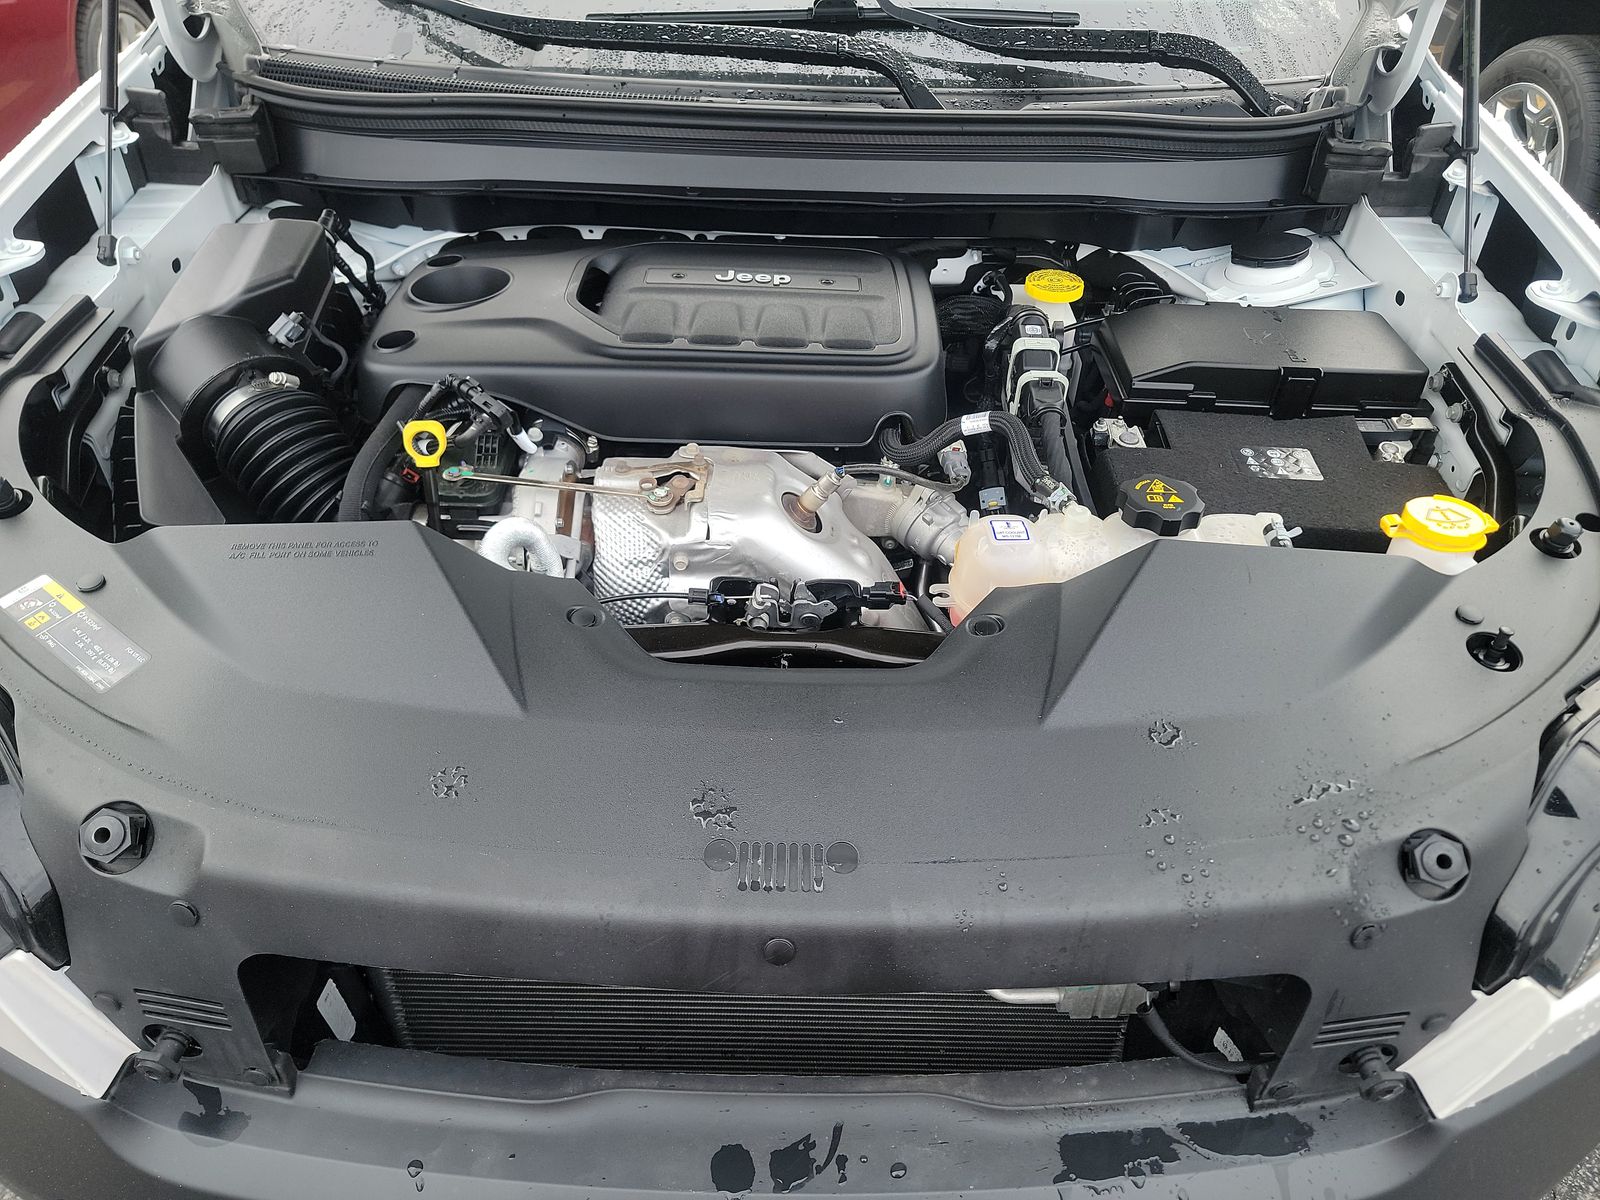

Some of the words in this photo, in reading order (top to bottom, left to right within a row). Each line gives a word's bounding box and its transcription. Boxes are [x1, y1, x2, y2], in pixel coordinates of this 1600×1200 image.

[715, 270, 791, 286] Jeep
[231, 543, 266, 551] REMOVE
[267, 542, 286, 550] THIS
[287, 541, 314, 550] PANEL
[315, 541, 333, 549] FOR
[333, 540, 366, 549] ACCESS
[368, 540, 379, 548] TO
[228, 552, 246, 560] A/C
[249, 551, 266, 559] FILL
[268, 551, 291, 559] PORT
[293, 550, 307, 558] ON
[307, 550, 333, 558] SOME
[335, 549, 375, 558] VEHICLES
